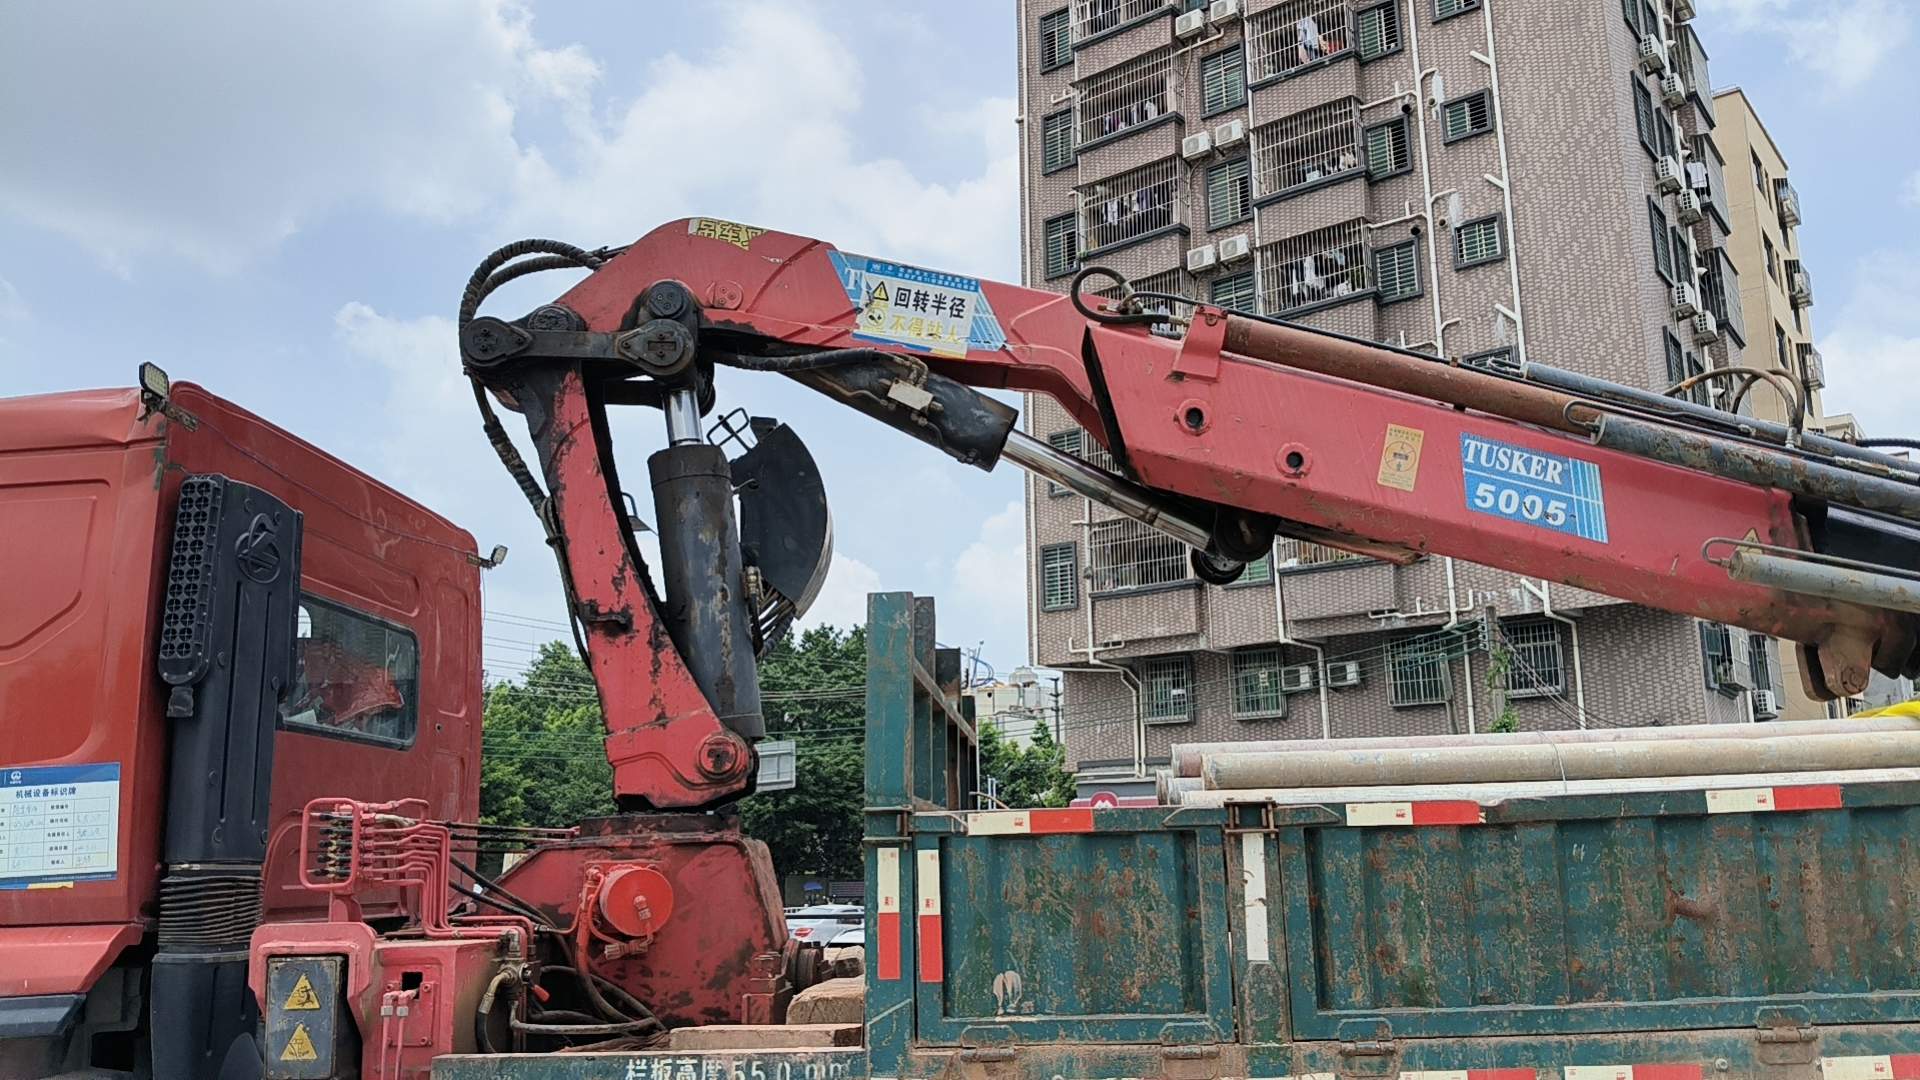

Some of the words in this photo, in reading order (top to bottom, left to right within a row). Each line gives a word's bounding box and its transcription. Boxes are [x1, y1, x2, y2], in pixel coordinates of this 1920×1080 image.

[894, 286, 966, 319] 回转半径
[1463, 439, 1564, 484] TUSKER
[1473, 483, 1567, 526] 5005
[15, 786, 77, 799] 机械设备标识牌
